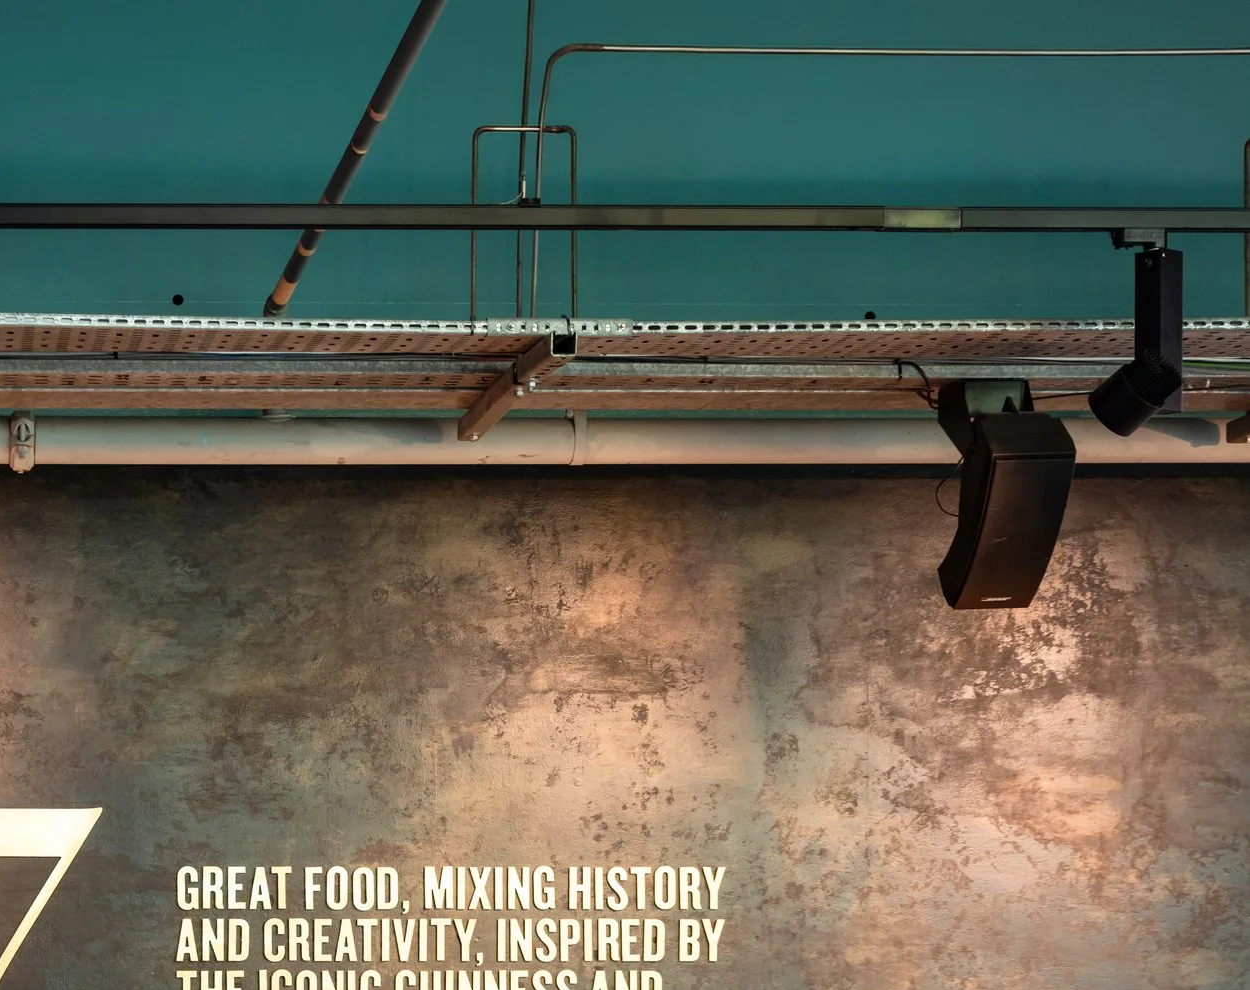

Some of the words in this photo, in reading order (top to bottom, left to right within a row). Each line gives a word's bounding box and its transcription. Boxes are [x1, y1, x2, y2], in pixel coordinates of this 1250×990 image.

[176, 866, 292, 911] GREAT
[305, 866, 410, 915] FOOD,
[423, 866, 556, 911] MIXING
[567, 866, 726, 911] HISTORY
[176, 918, 250, 962] AND
[263, 918, 484, 967] CREATIVITY,
[496, 918, 667, 962] INSPIRED
[679, 918, 726, 962] BY
